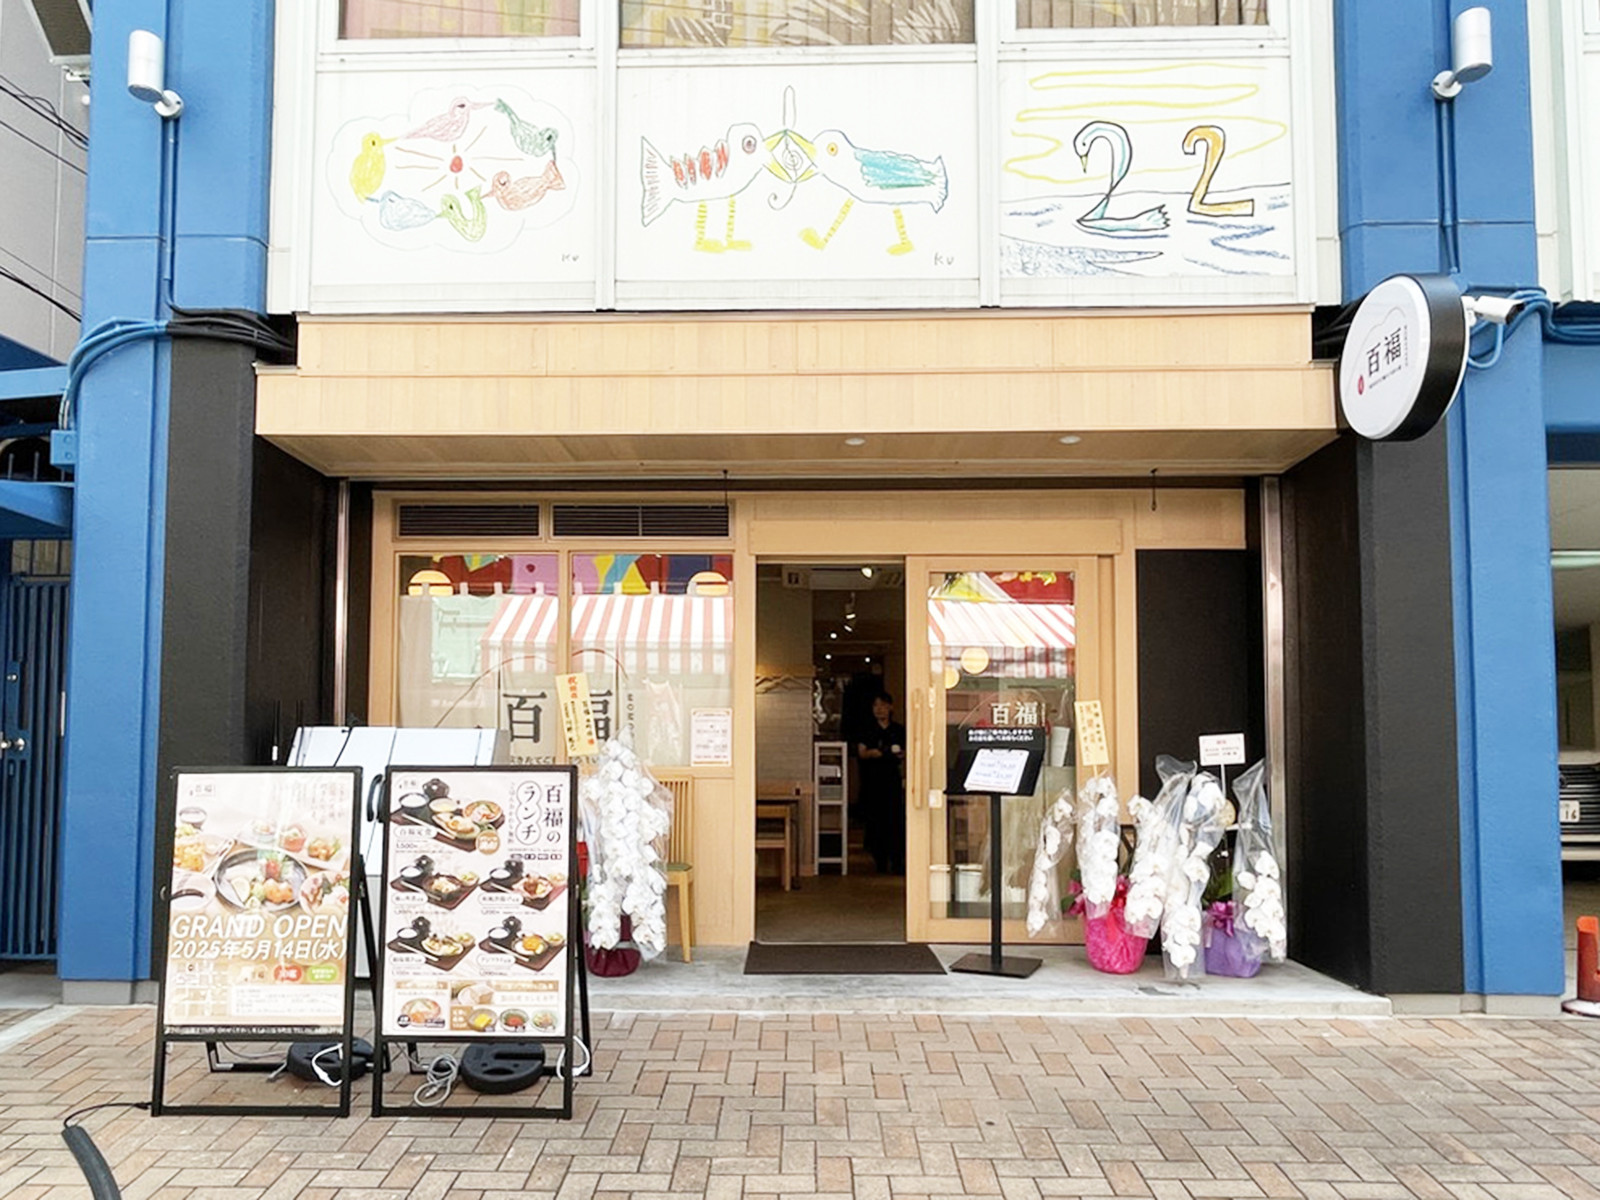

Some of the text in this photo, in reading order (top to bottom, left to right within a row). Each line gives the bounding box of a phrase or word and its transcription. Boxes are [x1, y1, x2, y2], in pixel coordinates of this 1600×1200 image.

[1366, 327, 1402, 378] 百福
[990, 701, 1039, 726] 百福
[521, 785, 537, 841] ランチ
[543, 784, 563, 843] 百福の
[171, 914, 348, 939] GRAND OPEN
[170, 939, 348, 960] 2025年5月14日(水)
